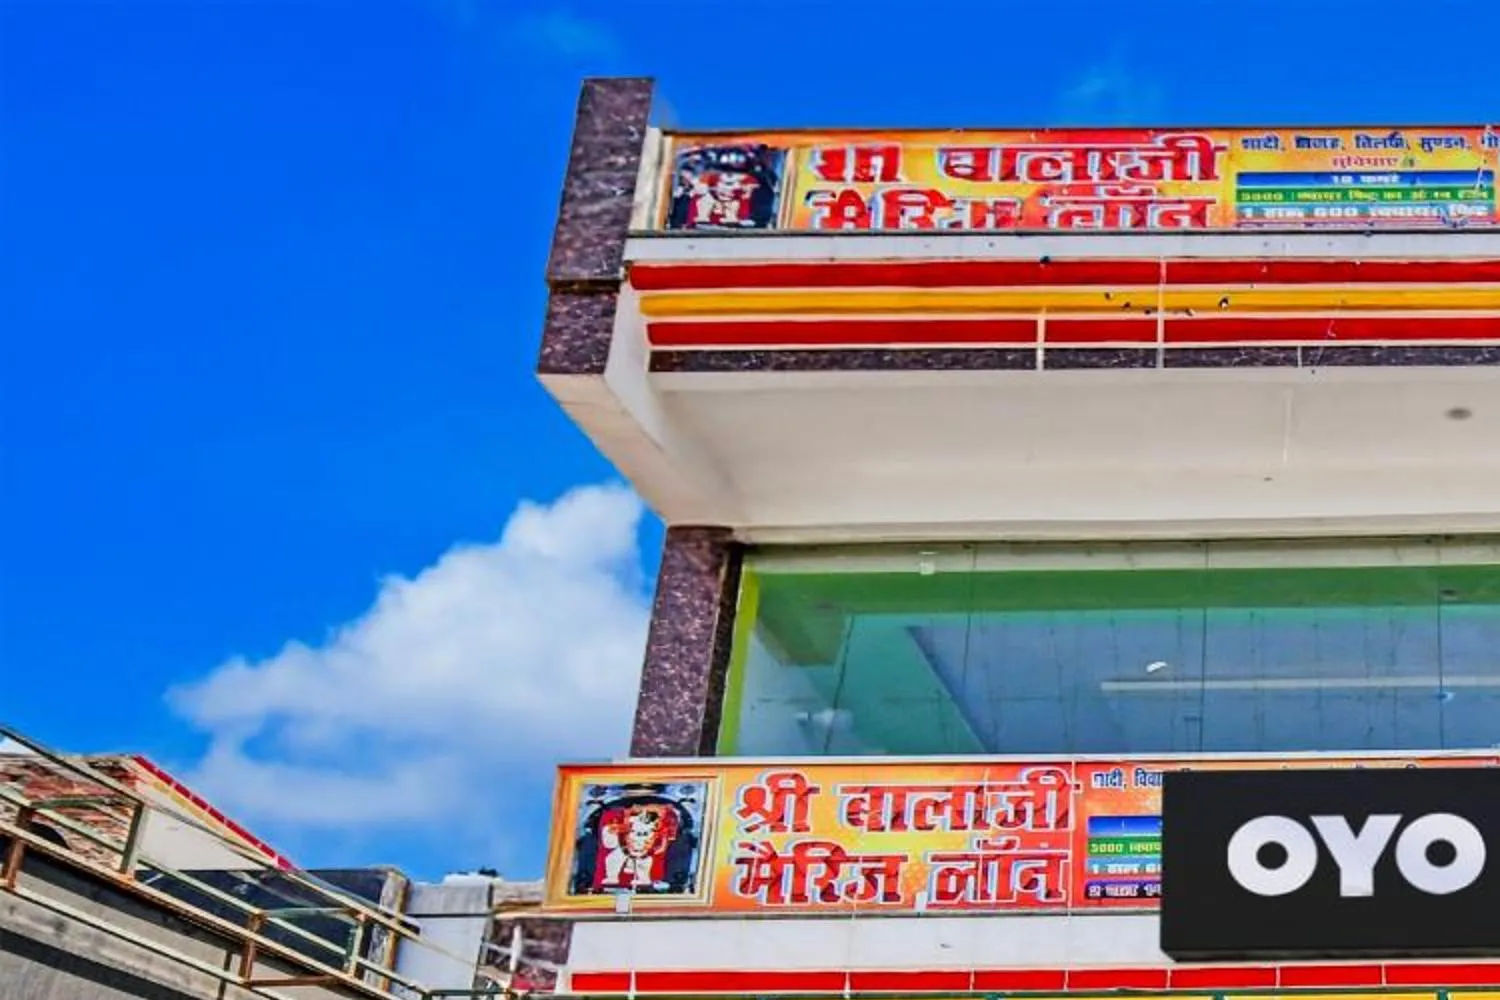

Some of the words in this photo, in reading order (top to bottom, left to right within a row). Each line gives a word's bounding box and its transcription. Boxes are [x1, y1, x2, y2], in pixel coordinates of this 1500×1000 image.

[735, 771, 821, 834] श्री
[837, 769, 1082, 833] बालाजी
[734, 840, 909, 905] मैरिज
[927, 836, 1070, 904] लॉन
[1227, 811, 1487, 898] OYO
